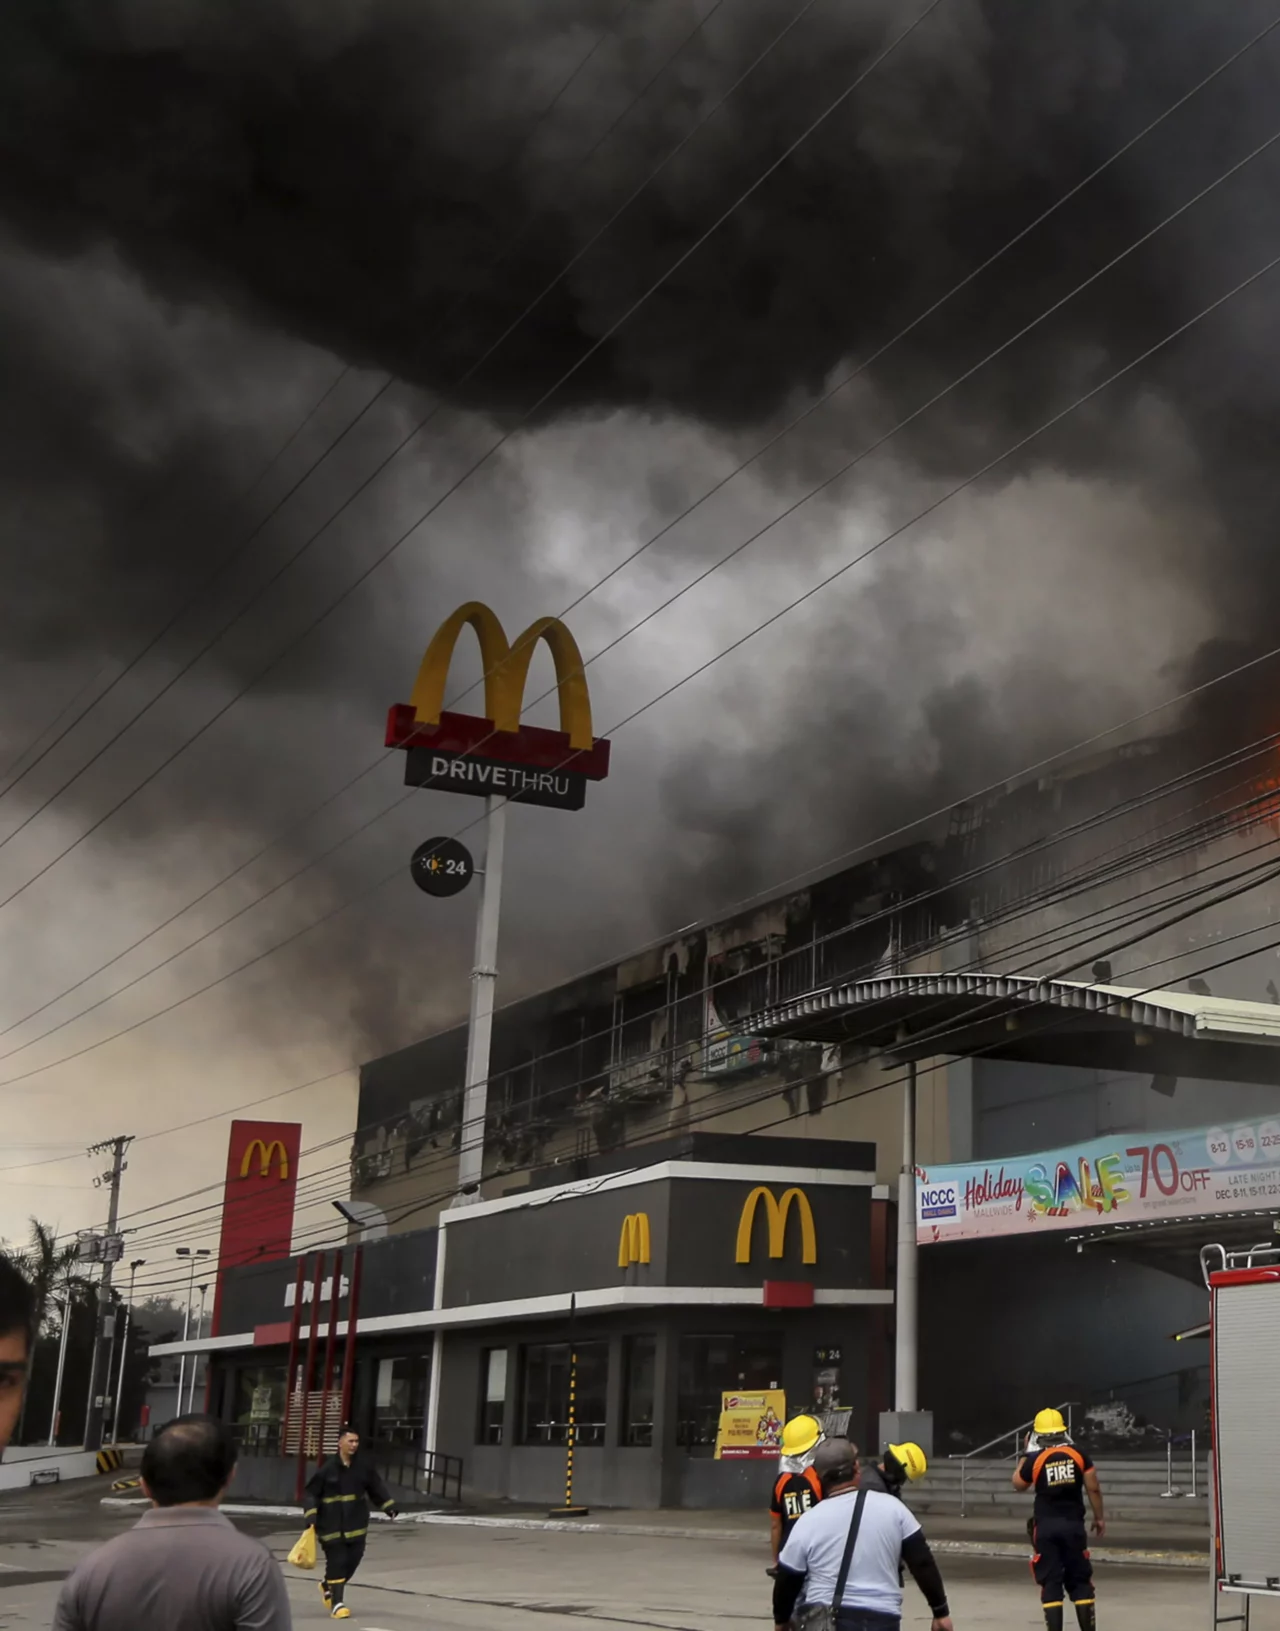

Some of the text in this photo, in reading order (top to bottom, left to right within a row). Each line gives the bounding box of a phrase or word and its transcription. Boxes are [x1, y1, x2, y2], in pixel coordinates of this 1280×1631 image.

[446, 859, 467, 876] 24
[1210, 1142, 1227, 1154] 8-12
[964, 1153, 1131, 1216] Holiday SALE
[1180, 1168, 1211, 1192] OFF
[1228, 1174, 1248, 1185] LATE
[1250, 1171, 1276, 1182] NIGHT
[922, 1188, 955, 1206] NCCC
[974, 1204, 1013, 1218] MALLWIDE
[829, 1350, 840, 1360] 24
[1046, 1464, 1075, 1482] FIRE
